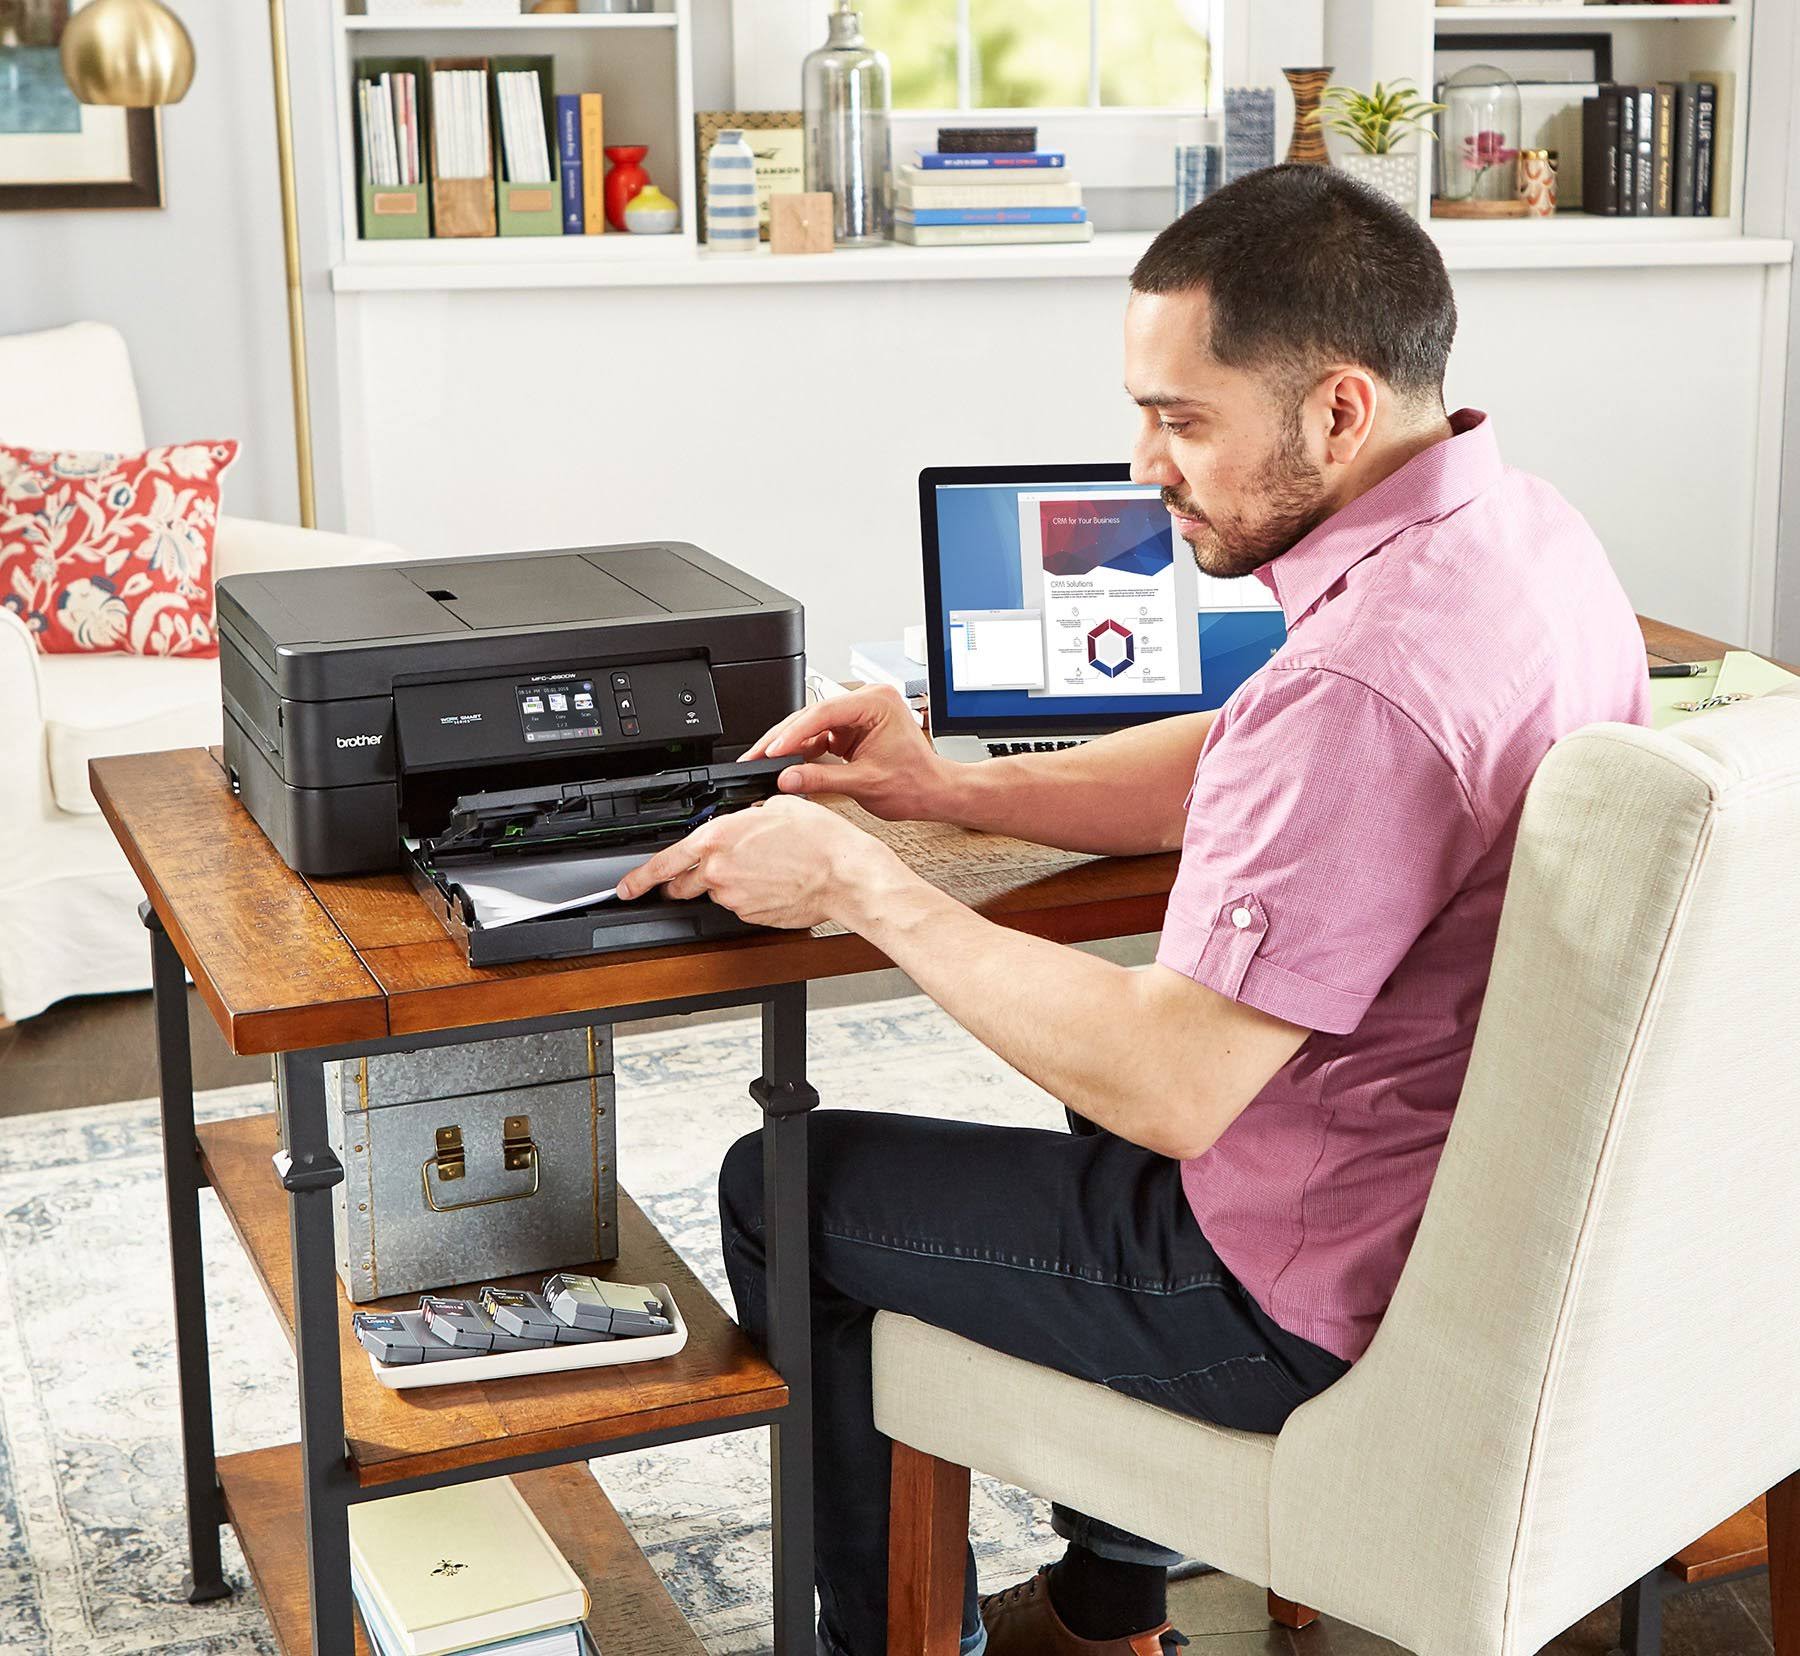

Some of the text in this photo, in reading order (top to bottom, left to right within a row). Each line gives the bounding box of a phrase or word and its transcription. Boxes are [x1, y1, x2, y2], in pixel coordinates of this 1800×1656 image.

[1699, 102, 1712, 140] BLUR
[1052, 517, 1067, 525] CRM
[1093, 516, 1120, 524] Business
[1050, 580, 1093, 588] CRM Solutions
[336, 735, 383, 748] brother
